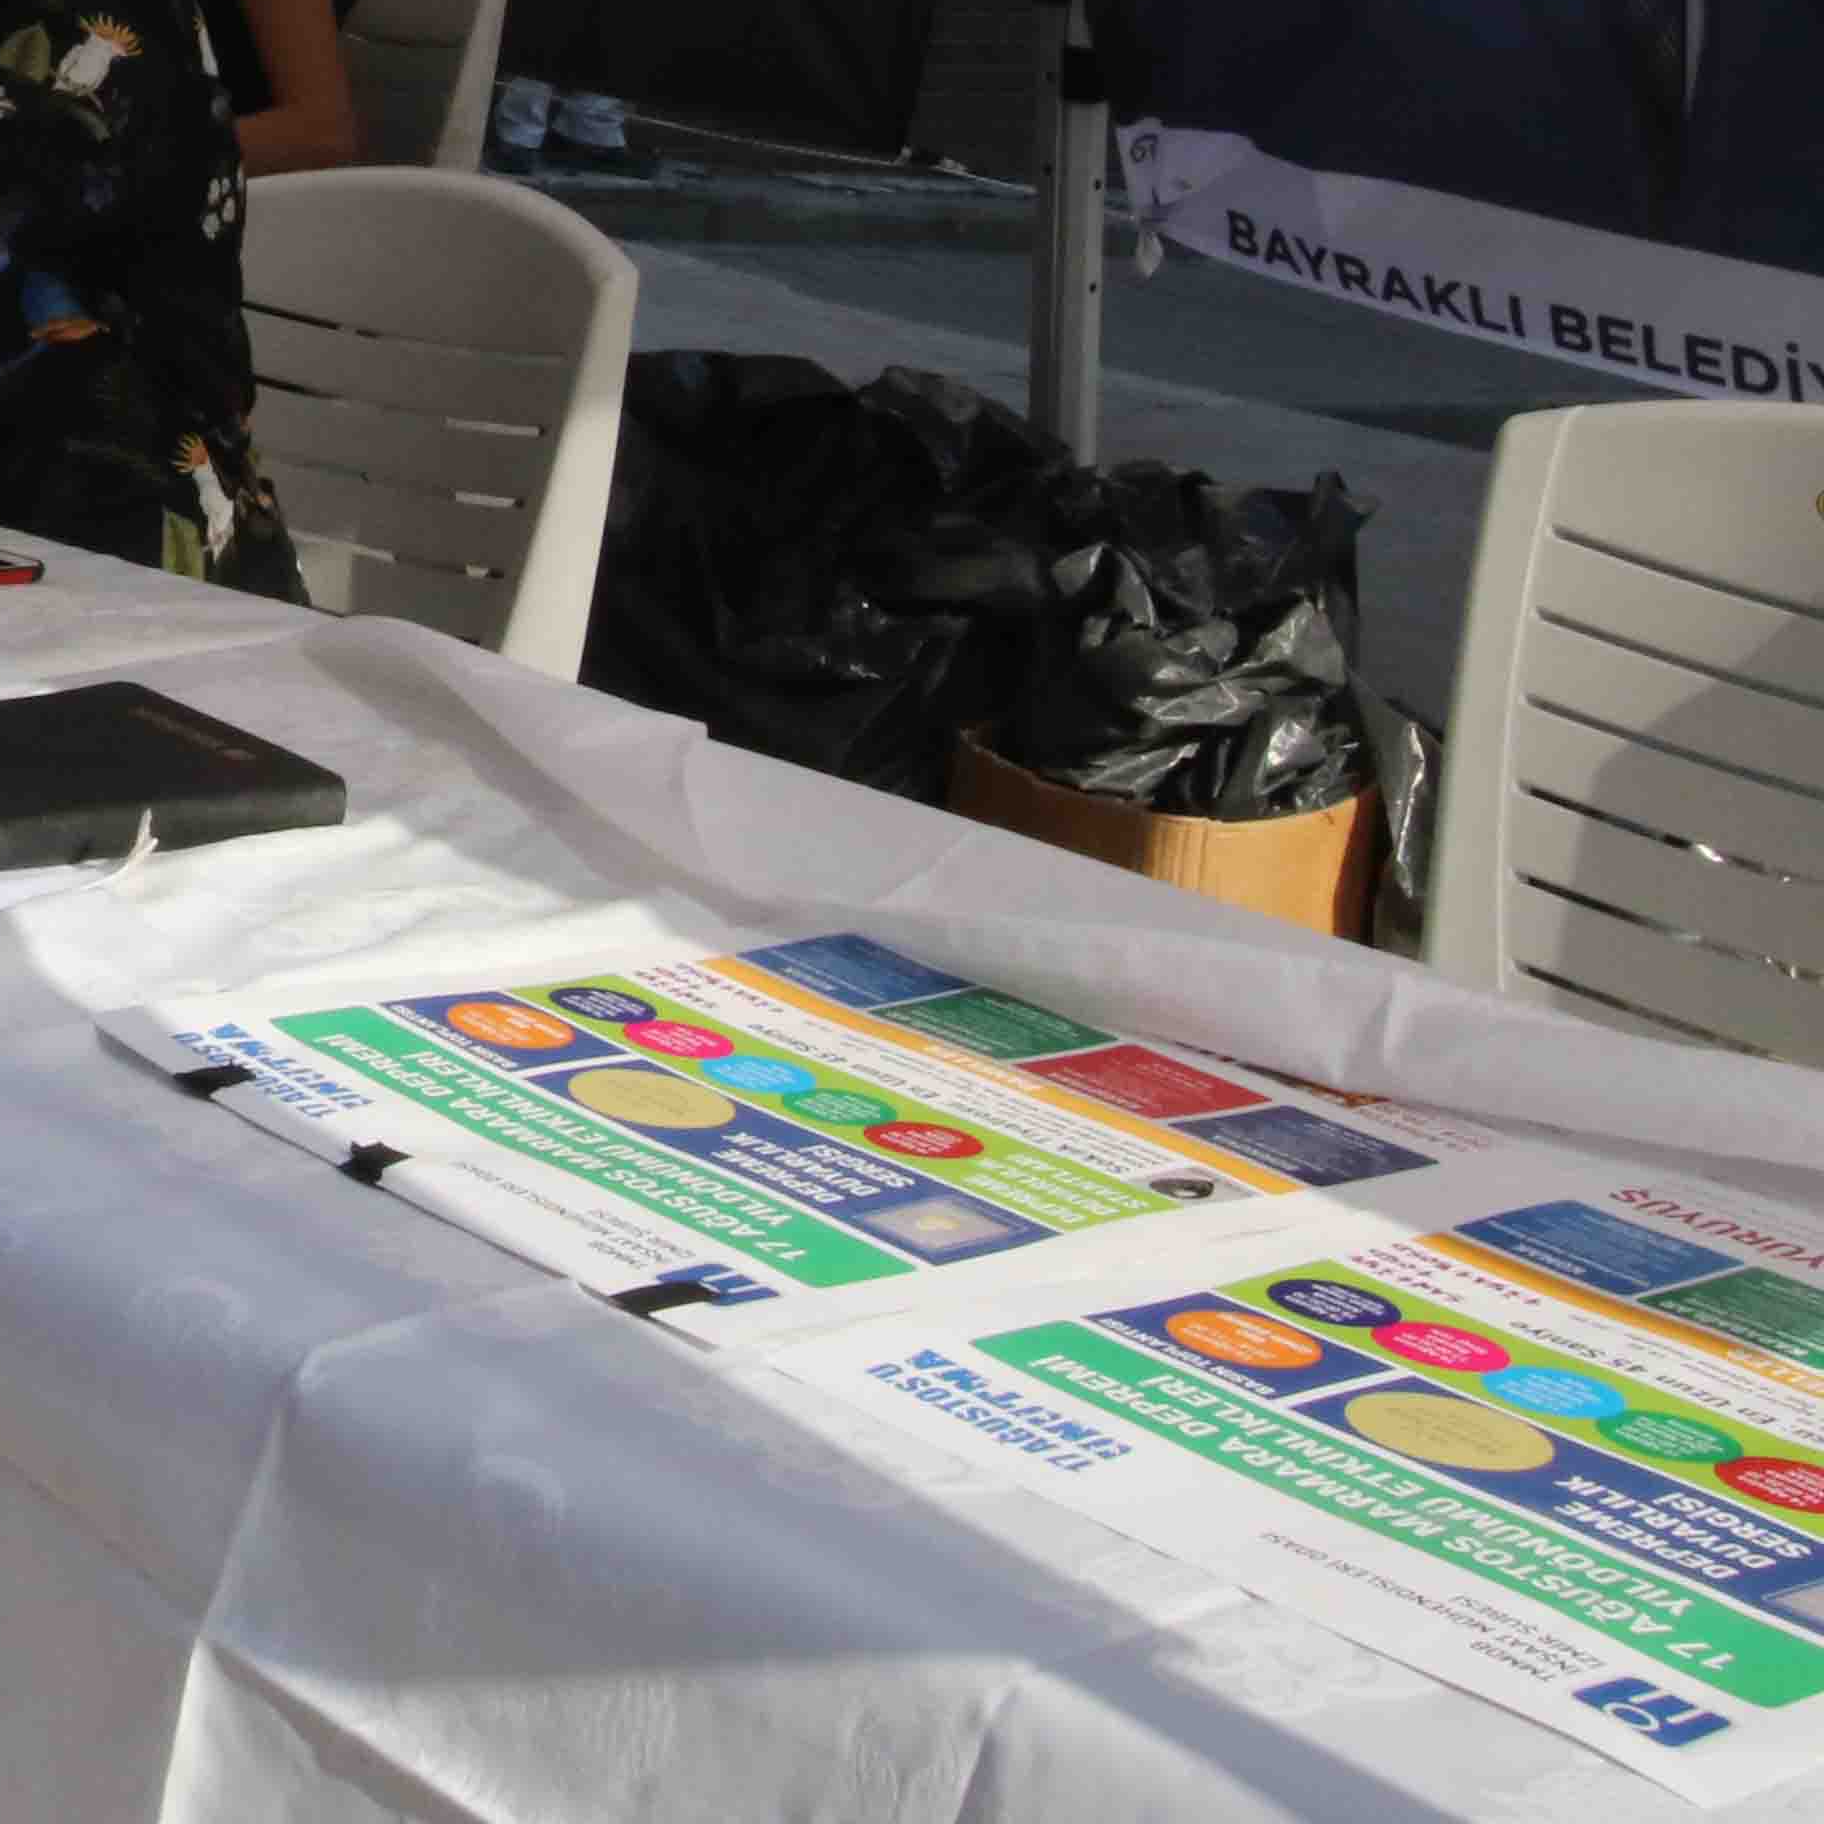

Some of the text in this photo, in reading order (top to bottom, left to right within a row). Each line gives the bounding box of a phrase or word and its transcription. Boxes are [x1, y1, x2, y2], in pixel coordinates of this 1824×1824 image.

[1225, 208, 1526, 339] BAYRAKLI
[314, 1032, 454, 1098] DEPREMİ
[402, 1050, 607, 1144] ETKİNLİKLERİ
[451, 1096, 610, 1171] MARMARA
[601, 1141, 793, 1228] YILDÖNÜMÜ
[603, 1168, 767, 1241] AĞUSTOS
[710, 1148, 846, 1204] DEPREME
[752, 1239, 808, 1262] 17
[1044, 1452, 1093, 1473] 17
[1139, 1375, 1695, 1617] YILDÖNÜMÜ ETKİNLİKLERİ
[1029, 1354, 1736, 1673] 17 AĞUSTOS MARMARA DEPREMİ
[1555, 1475, 1776, 1570] DUYARLILIK
[1555, 1501, 1740, 1579] DEPREME
[1652, 1491, 1812, 1559] SERGİSİ
